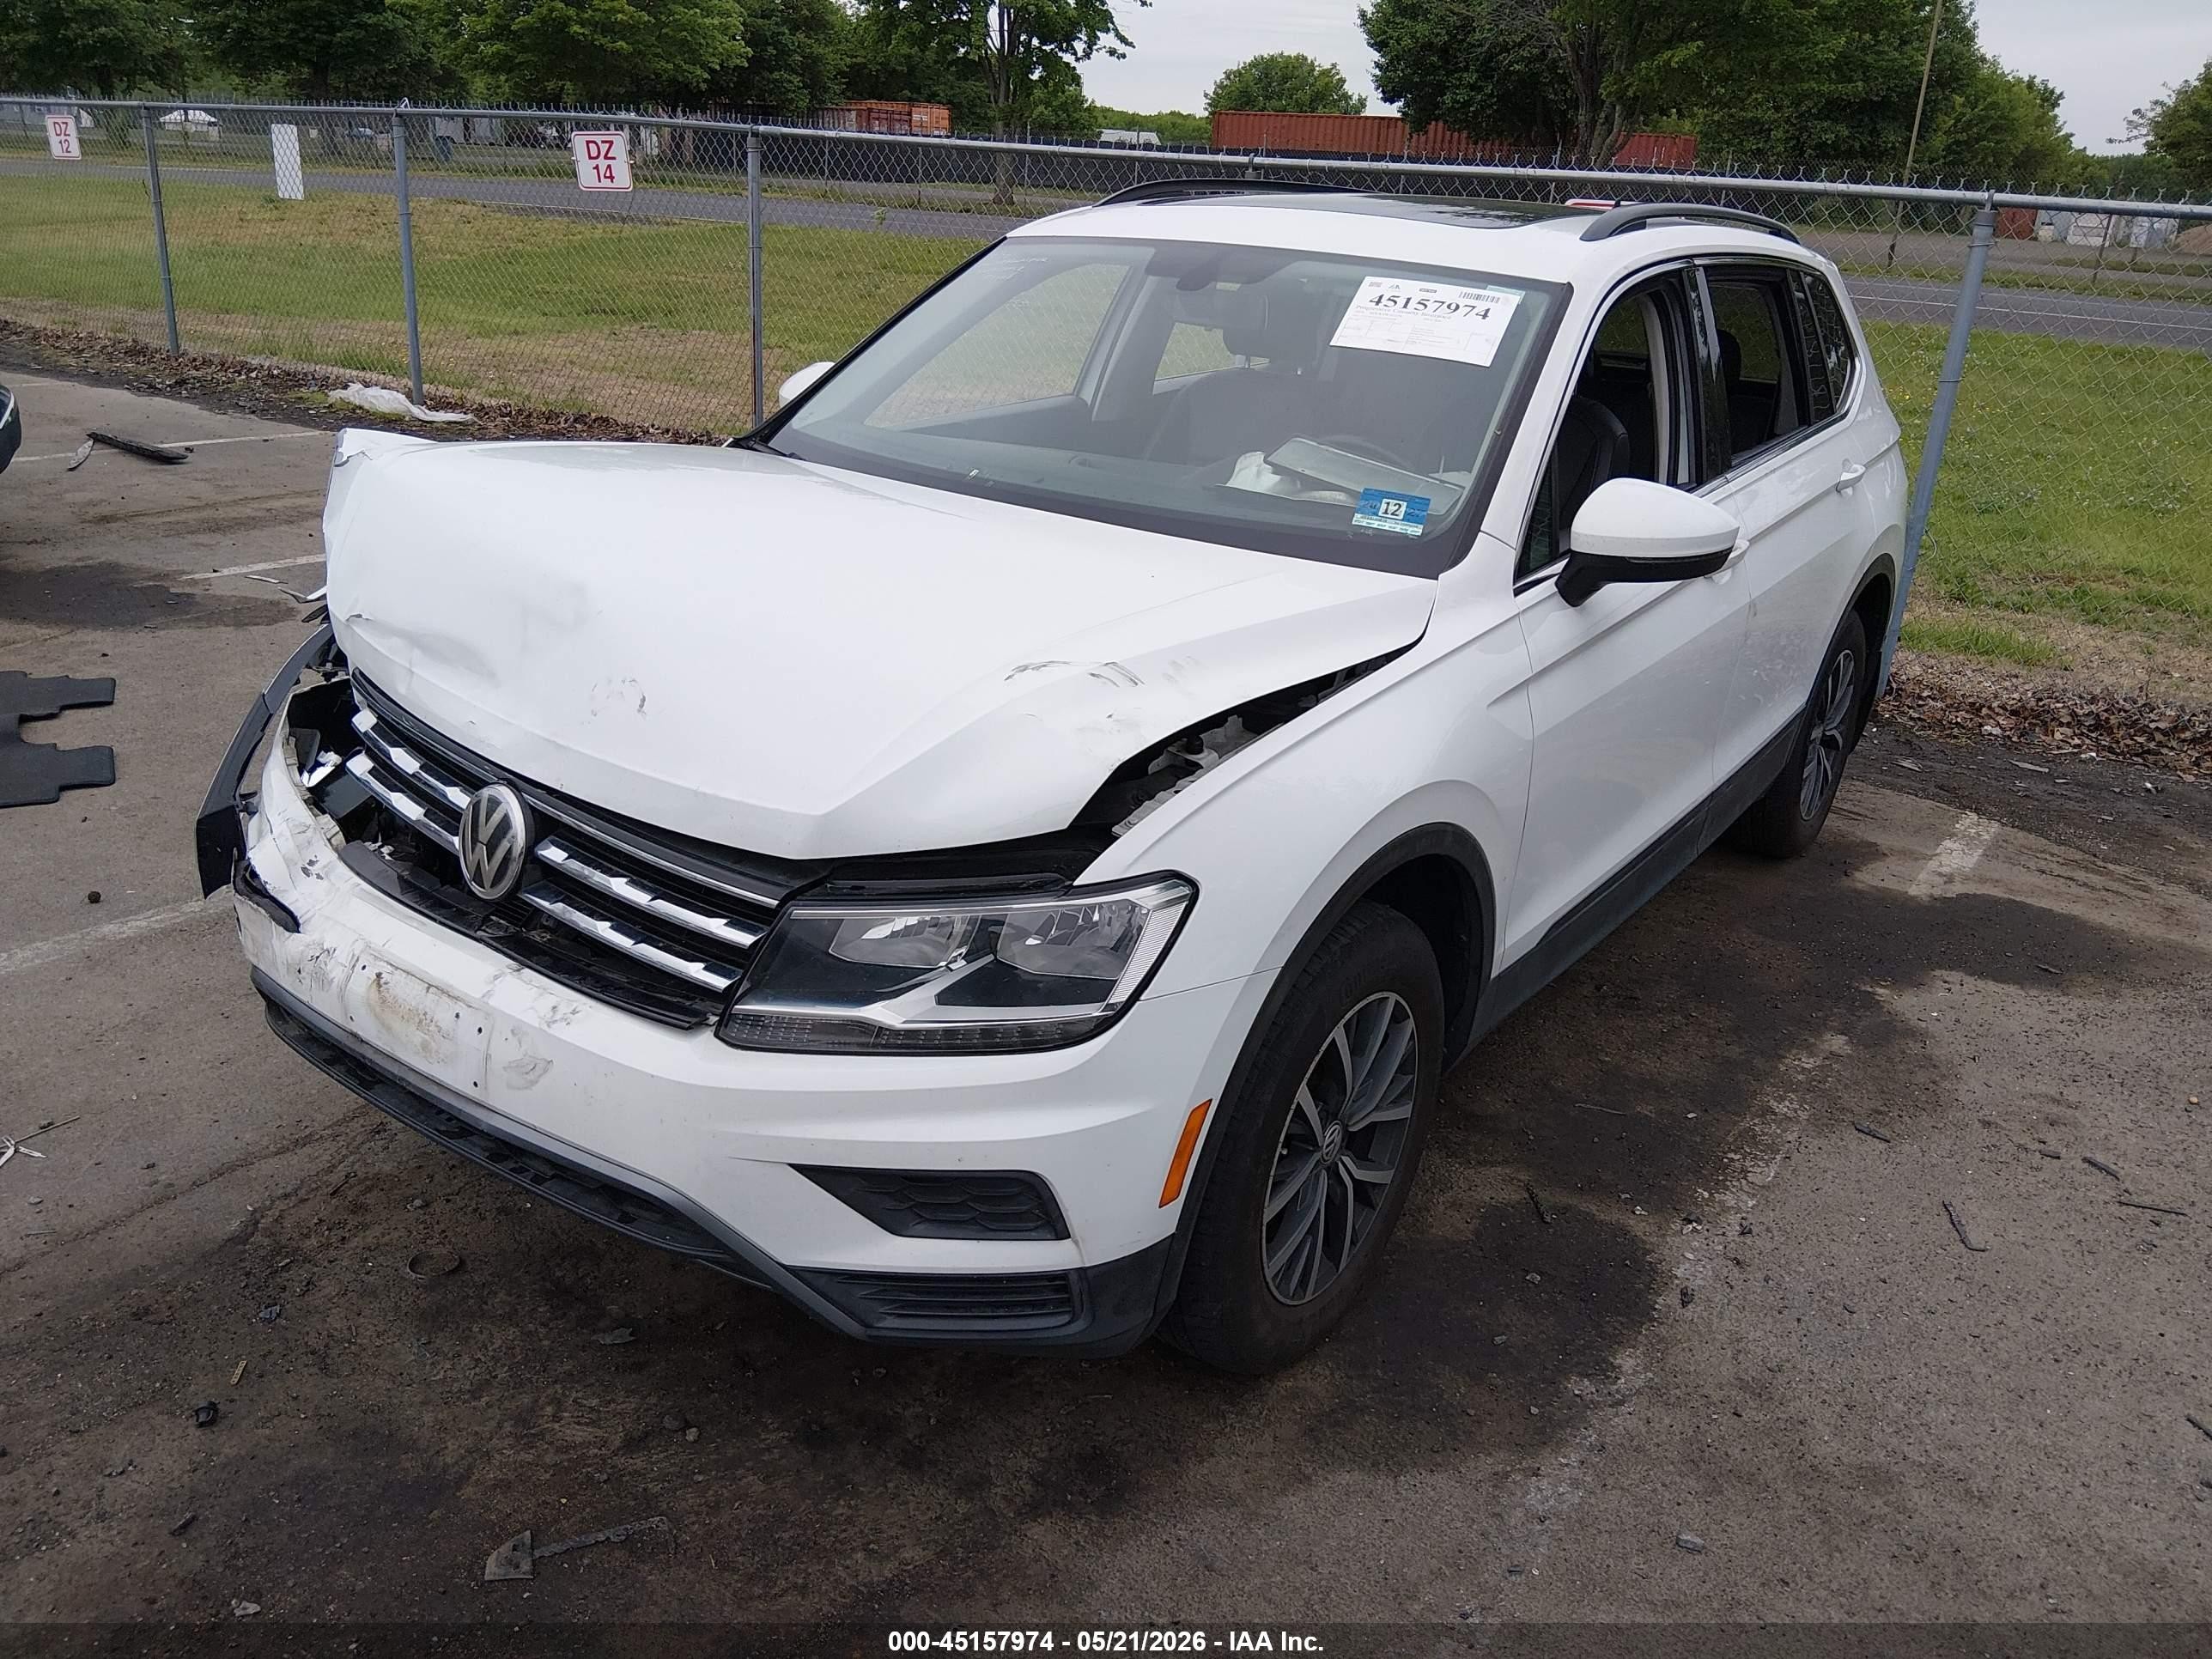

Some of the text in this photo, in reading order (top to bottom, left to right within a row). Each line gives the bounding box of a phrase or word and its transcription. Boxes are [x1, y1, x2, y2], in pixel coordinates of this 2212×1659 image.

[53, 121, 70, 137] DZ
[59, 138, 72, 154] 12
[585, 140, 617, 161] DZ
[592, 163, 616, 184] 14
[1369, 293, 1492, 320] 45157974
[1381, 501, 1402, 517] 12
[461, 785, 522, 896] VW
